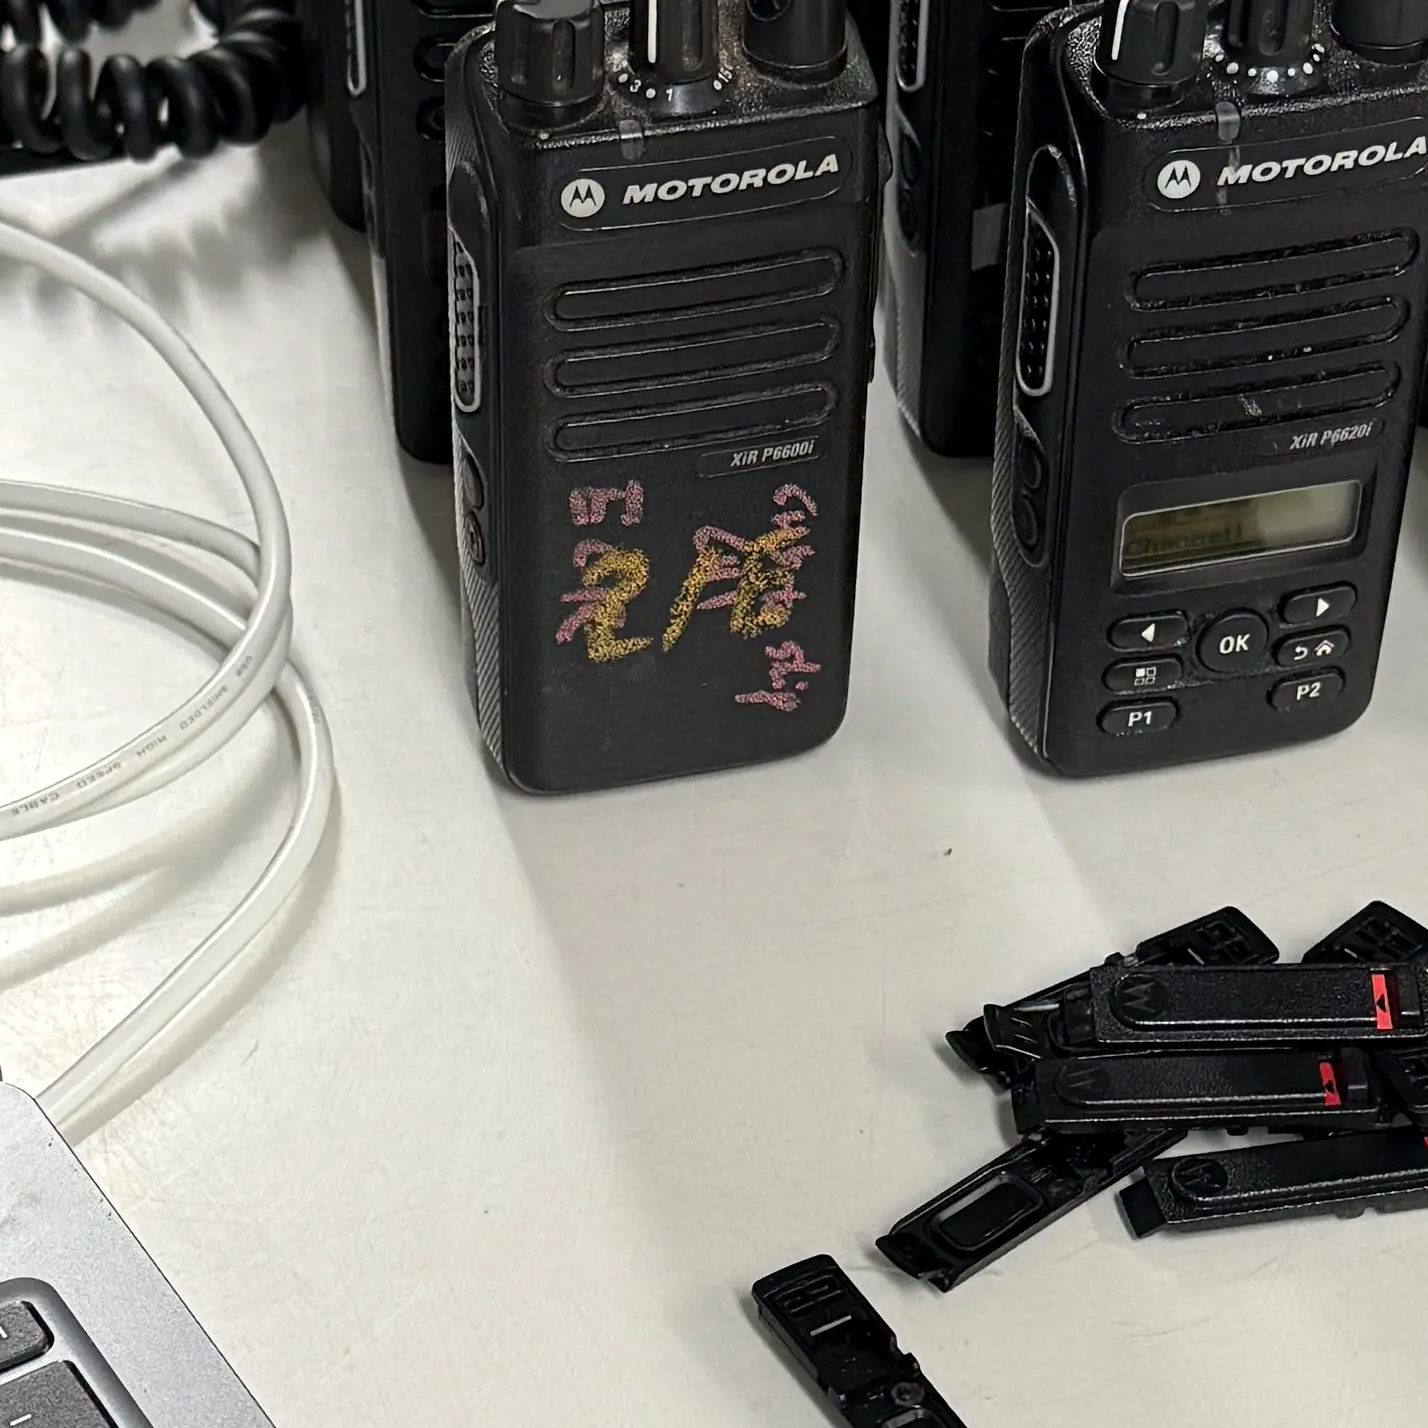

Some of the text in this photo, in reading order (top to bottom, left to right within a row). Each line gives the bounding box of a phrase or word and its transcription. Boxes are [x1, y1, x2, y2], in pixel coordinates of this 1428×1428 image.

[1216, 136, 1428, 189] MOTOROLA
[622, 152, 840, 207] MOTOROLA
[1289, 422, 1373, 451] XiR P6620i
[730, 440, 815, 467] XiR P6600i
[1219, 634, 1251, 654] OK
[1296, 682, 1321, 700] P2
[1127, 708, 1154, 727] P1
